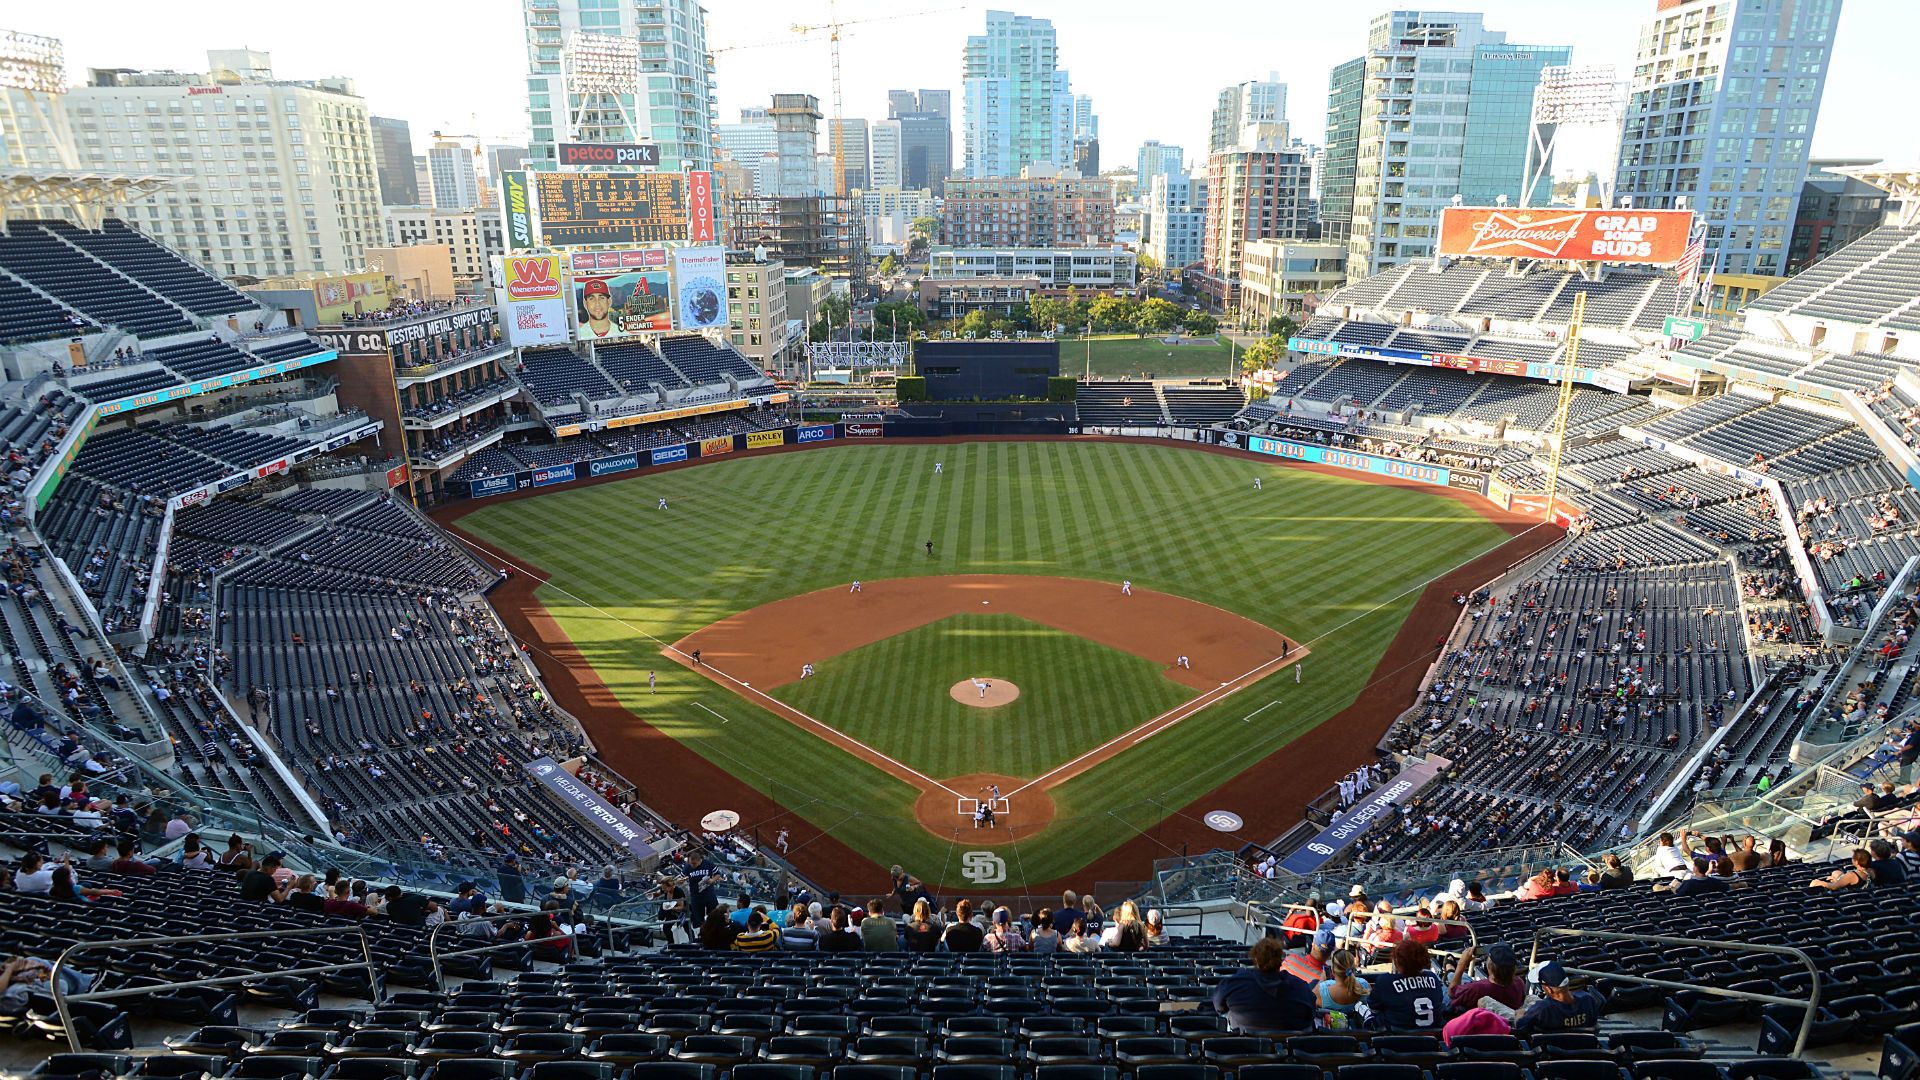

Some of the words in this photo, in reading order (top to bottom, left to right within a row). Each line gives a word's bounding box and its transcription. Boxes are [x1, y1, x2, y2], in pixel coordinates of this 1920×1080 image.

[188, 87, 223, 95] Marriott
[567, 146, 615, 163] petco
[616, 146, 652, 163] park
[510, 175, 530, 246] SUBWAY
[696, 175, 709, 239] TOYOTA
[1472, 222, 1577, 241] Budweiser
[1594, 216, 1657, 232] GRAB
[1603, 231, 1644, 242] SOME
[1591, 241, 1652, 257] BUDS
[512, 257, 551, 285] W
[387, 325, 426, 346] WESTERN
[428, 318, 453, 336] METAL
[453, 310, 480, 330] SUPPLY
[481, 307, 493, 323] CO.
[618, 316, 625, 331] 5
[625, 315, 645, 323] ENDER
[626, 322, 653, 331] INCIARTE
[357, 334, 386, 351] CO.
[919, 331, 926, 339] 6
[940, 331, 952, 339] 19
[965, 331, 977, 339] 31
[990, 331, 1003, 339] 35
[1016, 331, 1028, 339] 51
[1041, 331, 1054, 339] 42
[803, 341, 913, 357] NATIONAL
[813, 355, 904, 367] UNIVERSITY
[747, 432, 783, 443] STANLEY
[799, 429, 824, 440] ARCO
[847, 424, 880, 436] Sycuan
[1259, 440, 1275, 453] LAS
[653, 448, 686, 461] GEICO
[1321, 450, 1338, 463] LAS
[591, 456, 637, 474] QUALCOMM
[1385, 461, 1403, 474] LAS
[482, 477, 509, 488] ViaSat
[519, 479, 531, 488] 357
[552, 775, 586, 801] WELCOME
[583, 798, 595, 807] TO
[590, 804, 618, 824] PETCO
[612, 821, 638, 840] PARK
[1331, 822, 1358, 840] SAN
[1350, 804, 1381, 825] DIEGO
[1373, 780, 1413, 807] PADRES
[962, 851, 1007, 884] SD
[1392, 976, 1436, 993] GYORKO
[1413, 997, 1434, 1027] 9
